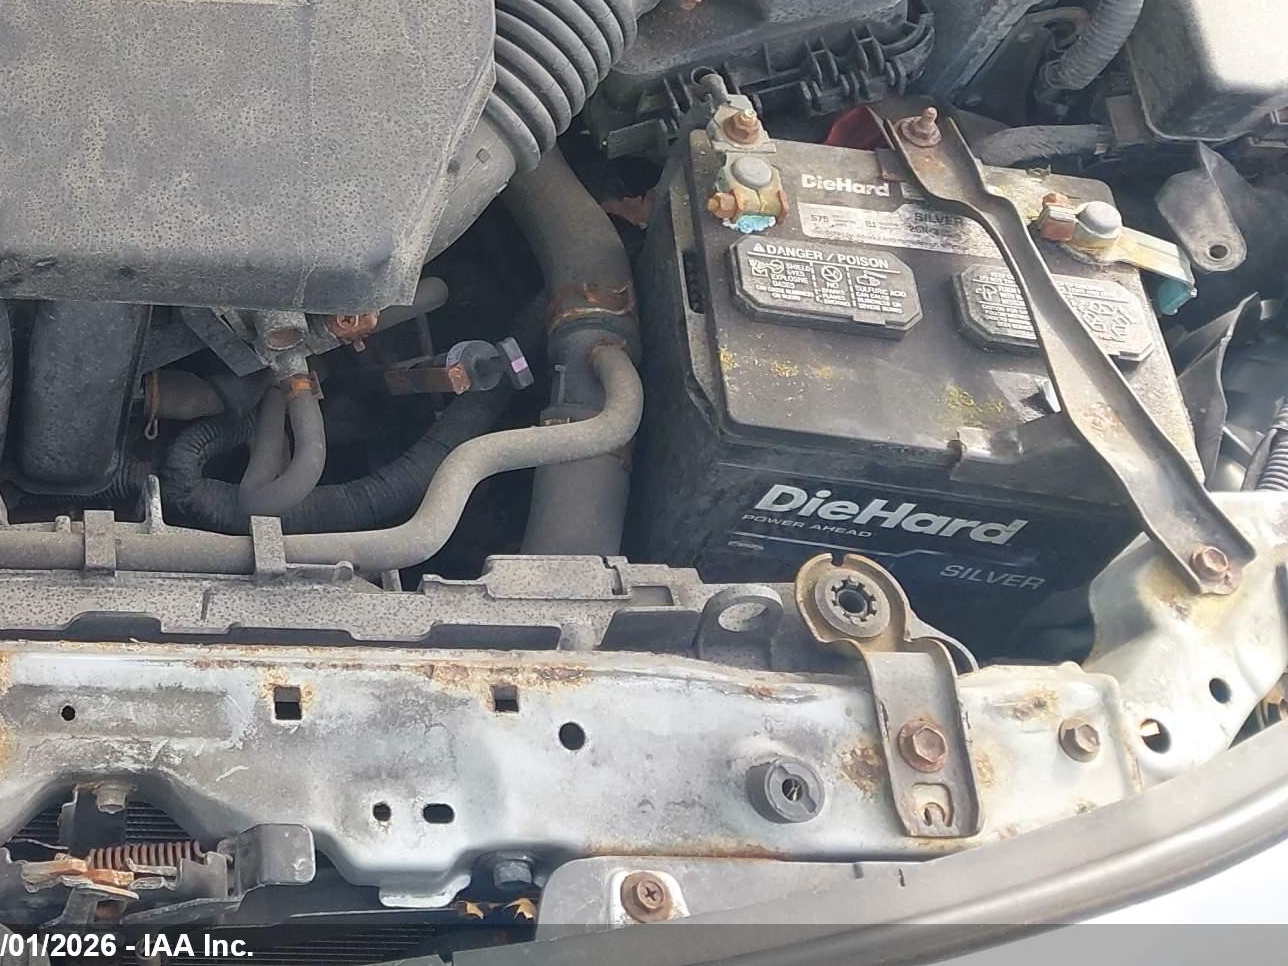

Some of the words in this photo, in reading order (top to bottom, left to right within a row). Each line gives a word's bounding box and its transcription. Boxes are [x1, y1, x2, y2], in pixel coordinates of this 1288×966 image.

[801, 174, 890, 197] DieHard
[914, 212, 963, 226] SILVER
[766, 245, 823, 260] DANGER
[838, 253, 889, 269] POISON
[742, 514, 805, 528] POWER
[808, 524, 873, 538] AHEAD
[754, 484, 1029, 546] DieHard
[939, 564, 1046, 590] SILVER
